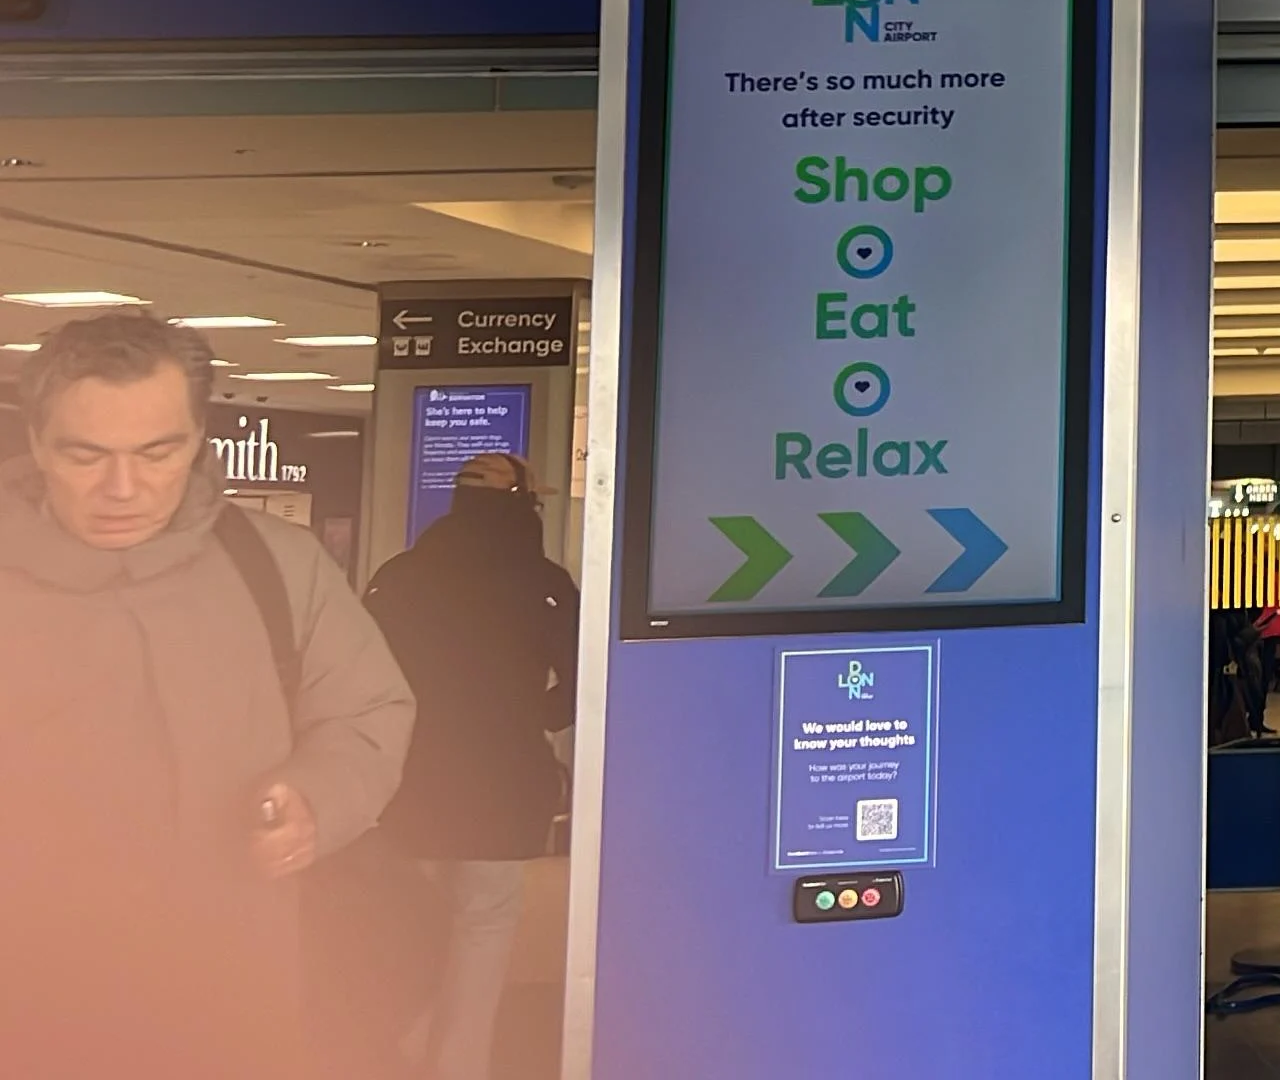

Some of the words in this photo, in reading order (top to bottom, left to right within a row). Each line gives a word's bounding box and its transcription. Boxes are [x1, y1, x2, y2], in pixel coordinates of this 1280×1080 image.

[884, 21, 913, 32] CITY
[884, 31, 938, 42] AIRPORT
[725, 71, 819, 92] There's
[826, 76, 855, 90] so
[863, 69, 933, 90] much
[940, 72, 1006, 89] more
[782, 107, 847, 128] after
[853, 105, 955, 129] security
[794, 155, 952, 213] Shop
[458, 310, 556, 330] Currency
[815, 293, 916, 340] Eat
[457, 336, 564, 357] Exchange
[426, 407, 450, 417] She's
[452, 406, 473, 416] here
[475, 406, 486, 416] to
[487, 406, 509, 417] help
[425, 418, 447, 427] keep
[449, 419, 468, 428] you
[774, 428, 949, 480] Relax
[281, 465, 307, 481] 1792
[802, 723, 823, 734] We
[825, 721, 863, 734] would
[866, 720, 892, 732] love
[894, 720, 908, 731] to
[794, 738, 828, 751] know
[829, 739, 858, 751] your
[860, 734, 915, 748] thoughts
[849, 763, 867, 772] your
[821, 774, 836, 783] the
[837, 772, 866, 782] airport
